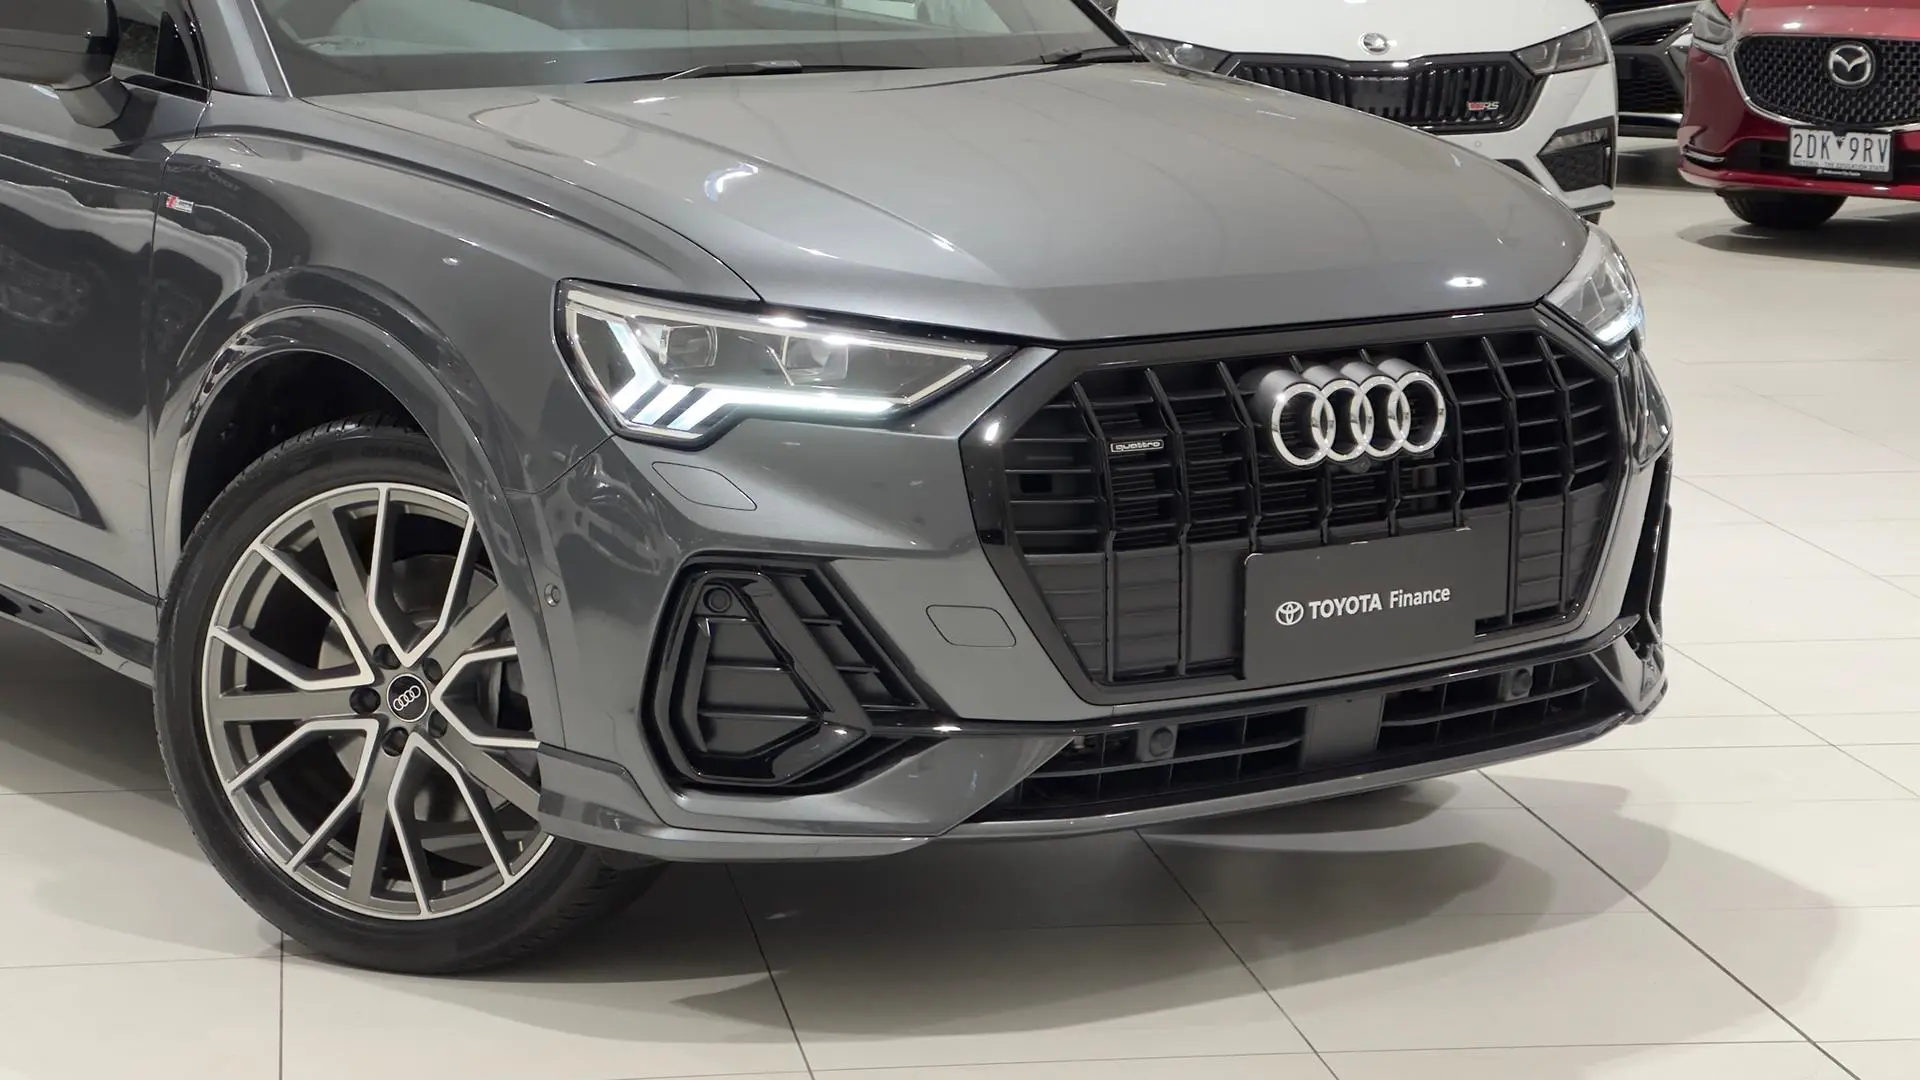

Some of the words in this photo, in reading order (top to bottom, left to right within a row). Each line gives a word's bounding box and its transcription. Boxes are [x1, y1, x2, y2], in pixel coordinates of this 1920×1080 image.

[1793, 134, 1831, 160] 2DK
[1849, 137, 1888, 163] 9RV
[1115, 441, 1161, 451] quattro
[1308, 593, 1383, 620] TOYOTA
[1389, 587, 1451, 609] Finance
